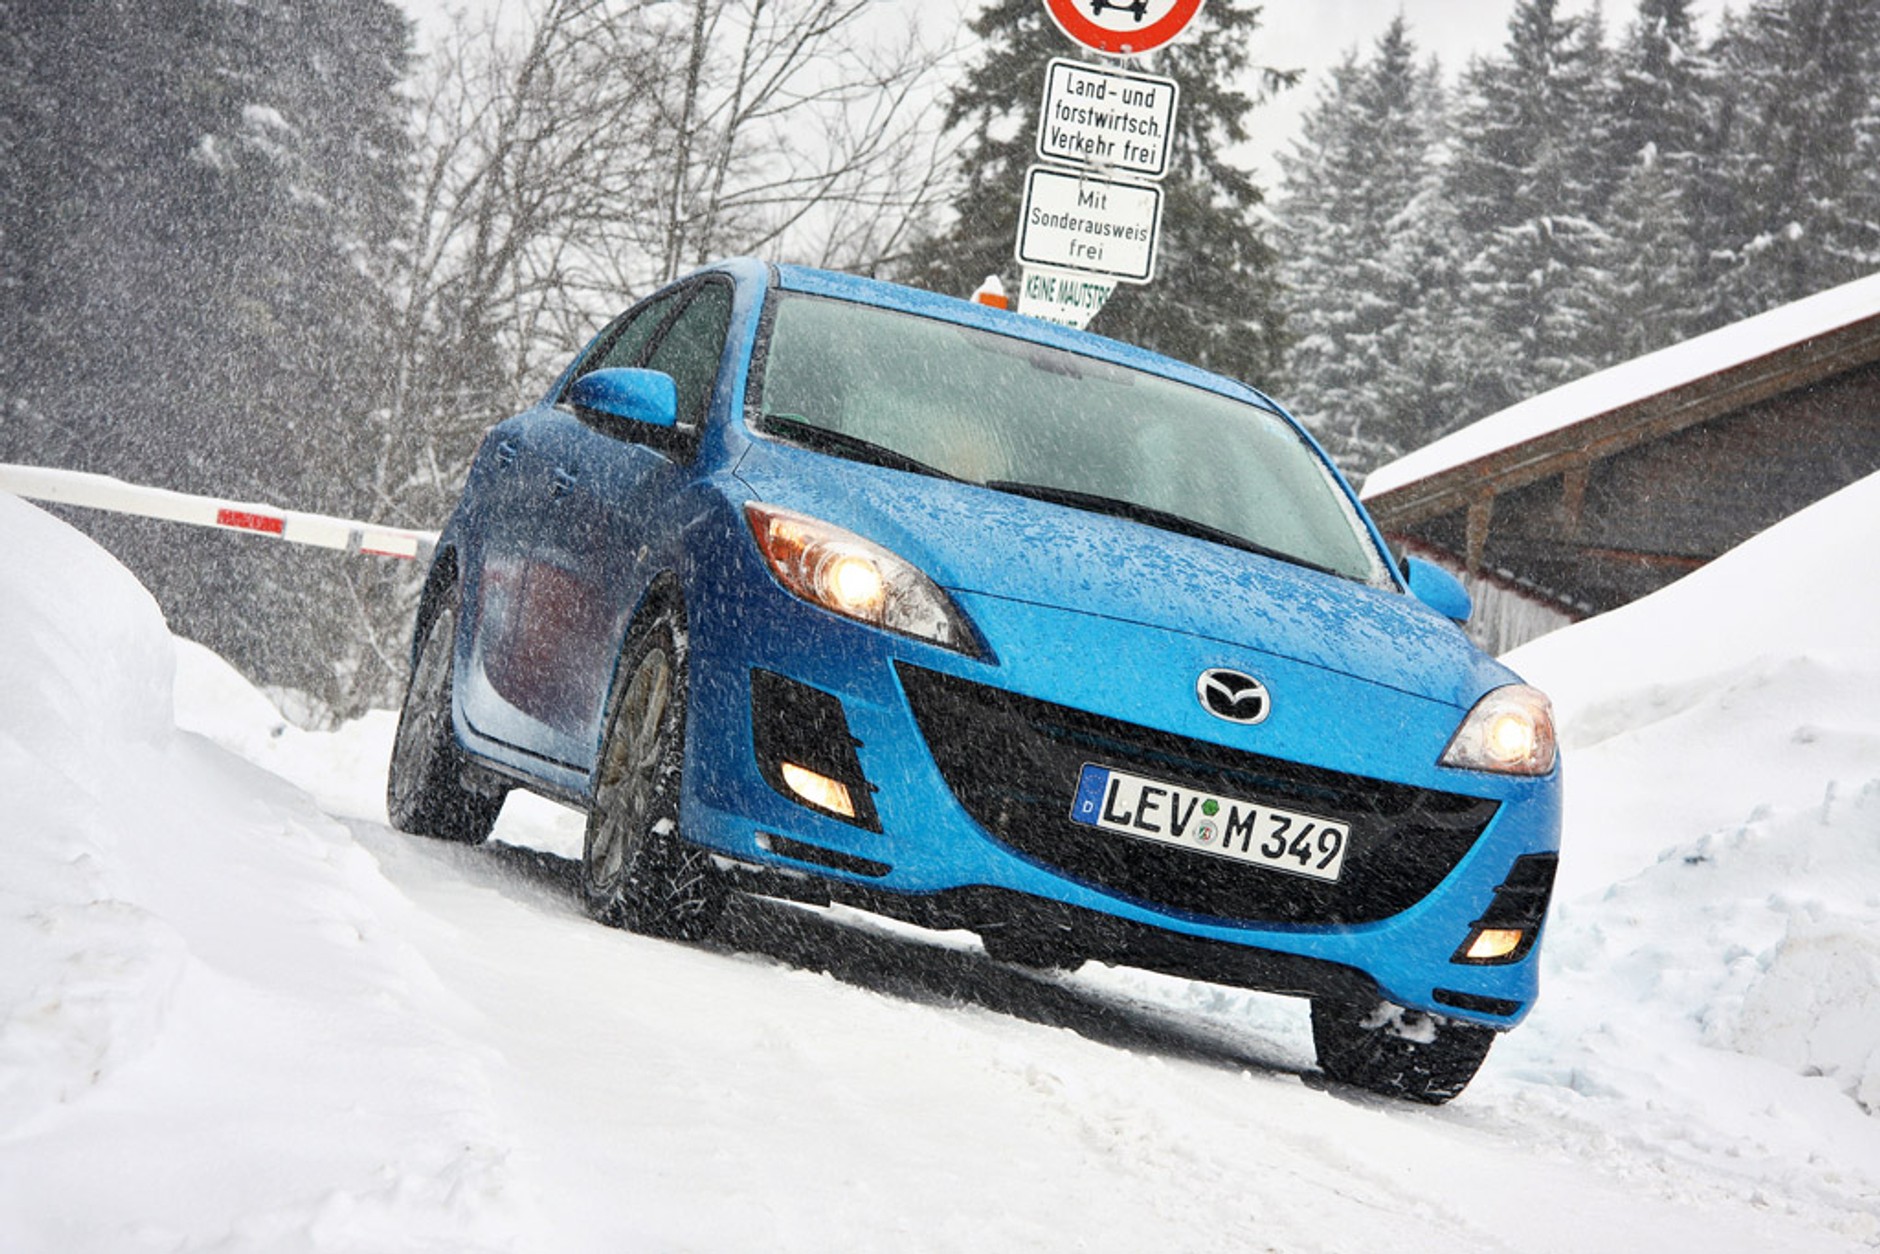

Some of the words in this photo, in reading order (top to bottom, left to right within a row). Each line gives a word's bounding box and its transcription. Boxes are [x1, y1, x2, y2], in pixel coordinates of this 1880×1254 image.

[1122, 88, 1156, 108] und
[1055, 99, 1161, 138] forstwirtsch.
[1051, 125, 1115, 156] Verkehr
[1123, 140, 1156, 164] frei
[1077, 189, 1107, 210] Mit
[1031, 207, 1148, 241] Sonderausweis
[1068, 239, 1103, 260] frei
[1025, 274, 1056, 302] KEINE
[1083, 800, 1094, 813] D
[1103, 778, 1198, 837] LEV
